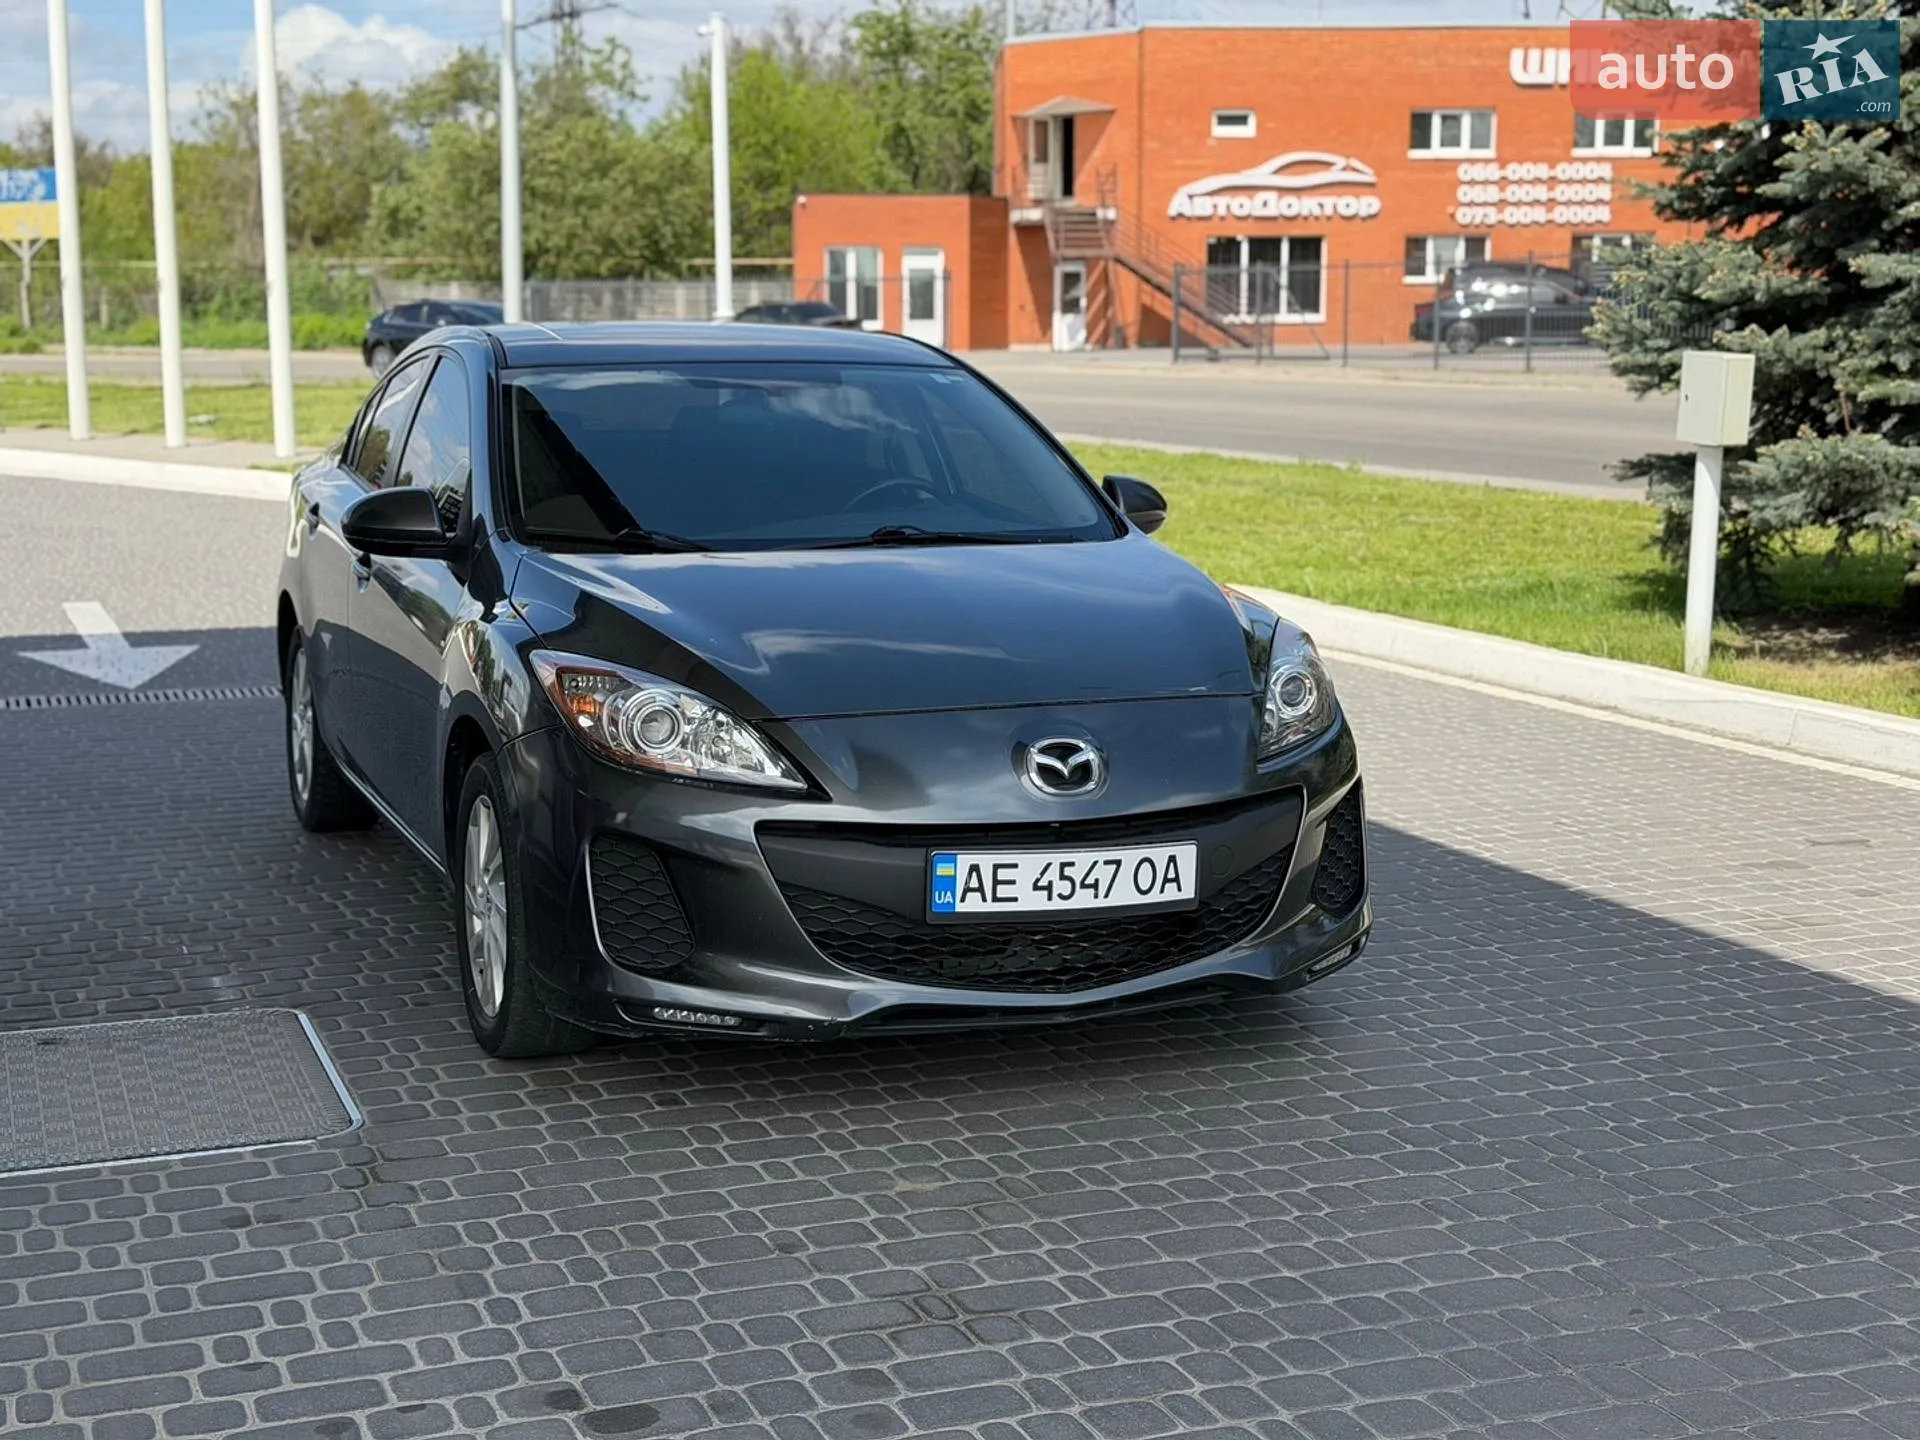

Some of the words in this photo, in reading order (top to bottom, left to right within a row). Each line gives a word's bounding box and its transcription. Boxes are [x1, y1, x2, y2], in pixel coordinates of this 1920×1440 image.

[959, 862, 1019, 904] AE
[1032, 858, 1123, 902] 4547
[1132, 854, 1183, 896] OA
[934, 890, 954, 905] UA
